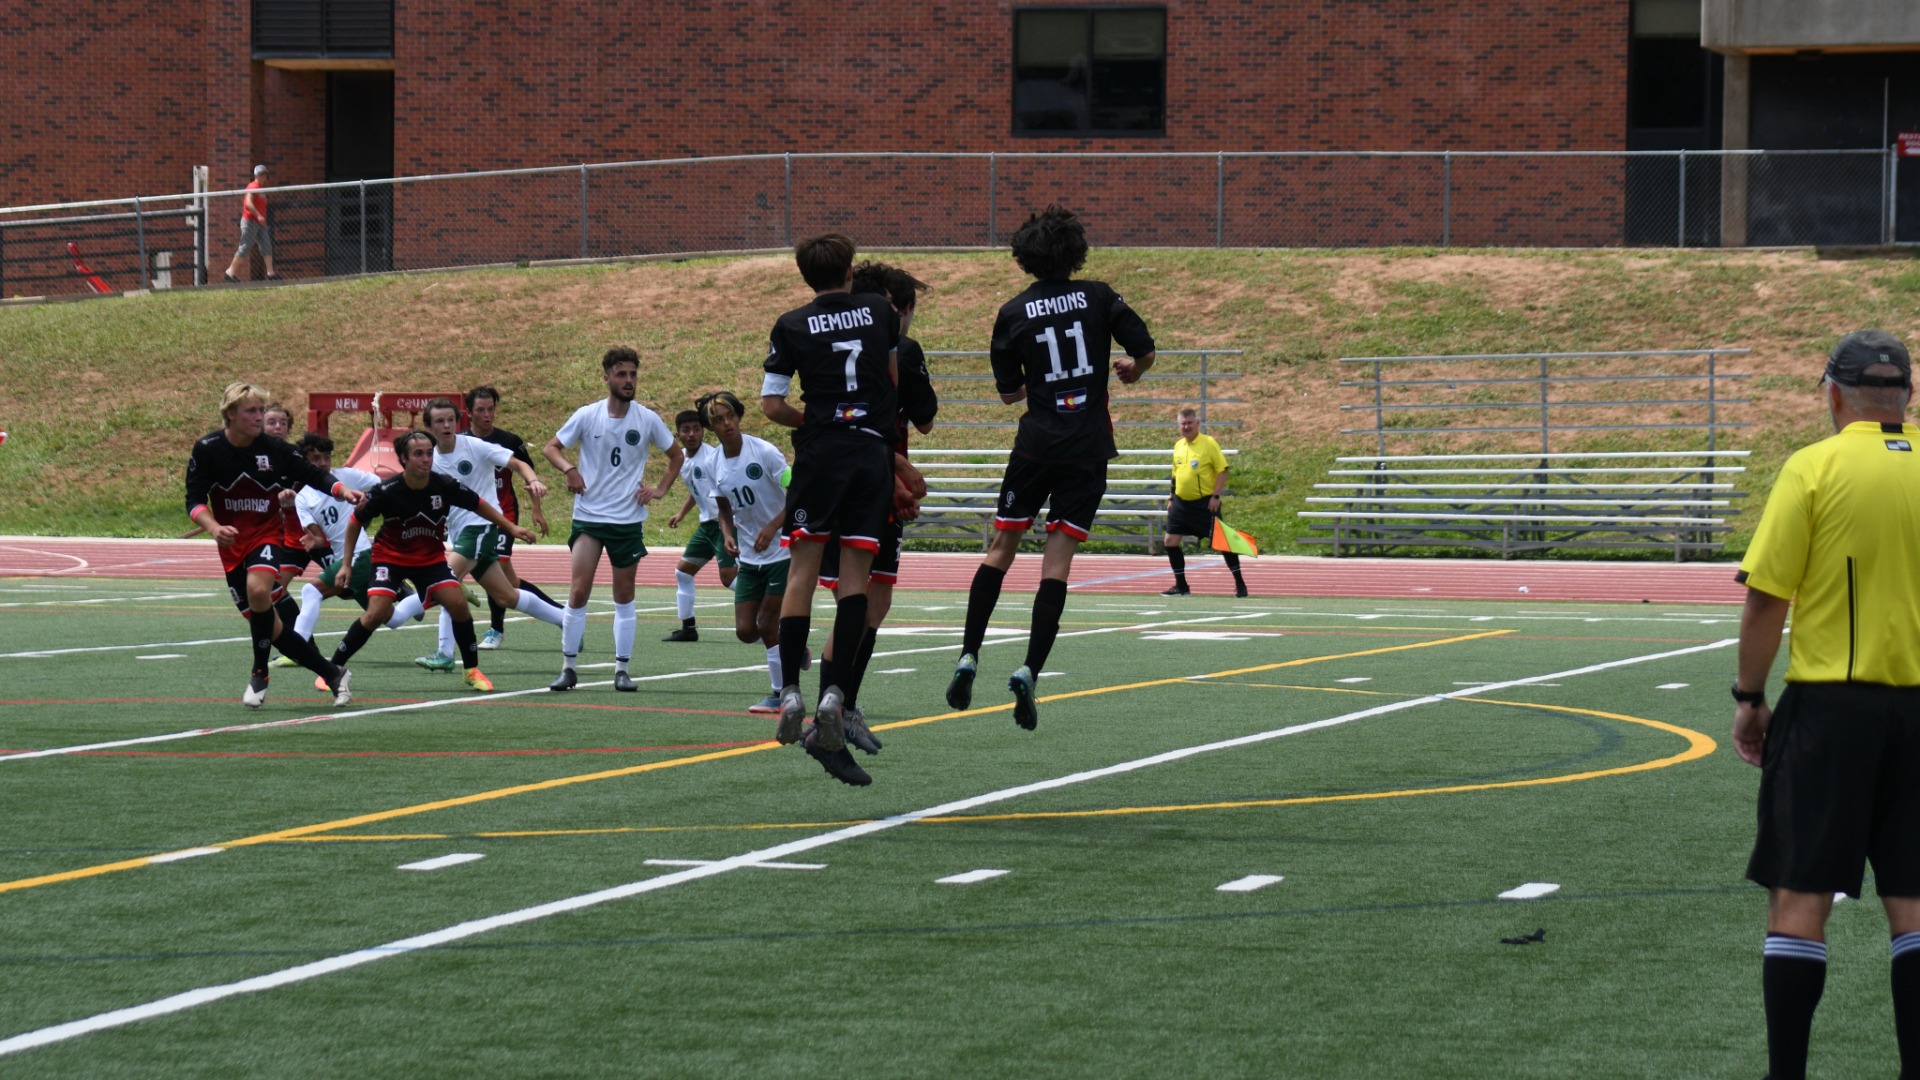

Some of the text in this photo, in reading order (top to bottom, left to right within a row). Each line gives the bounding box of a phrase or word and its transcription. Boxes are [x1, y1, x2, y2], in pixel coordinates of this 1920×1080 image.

[1025, 291, 1088, 319] DEMONS
[807, 306, 874, 335] DEMONS
[1035, 320, 1094, 383] 11
[831, 339, 863, 392] 7
[335, 398, 431, 409] NEW COUN
[610, 446, 622, 467] 6
[731, 485, 756, 508] 10
[320, 505, 339, 526] 19
[260, 544, 274, 560] 4
